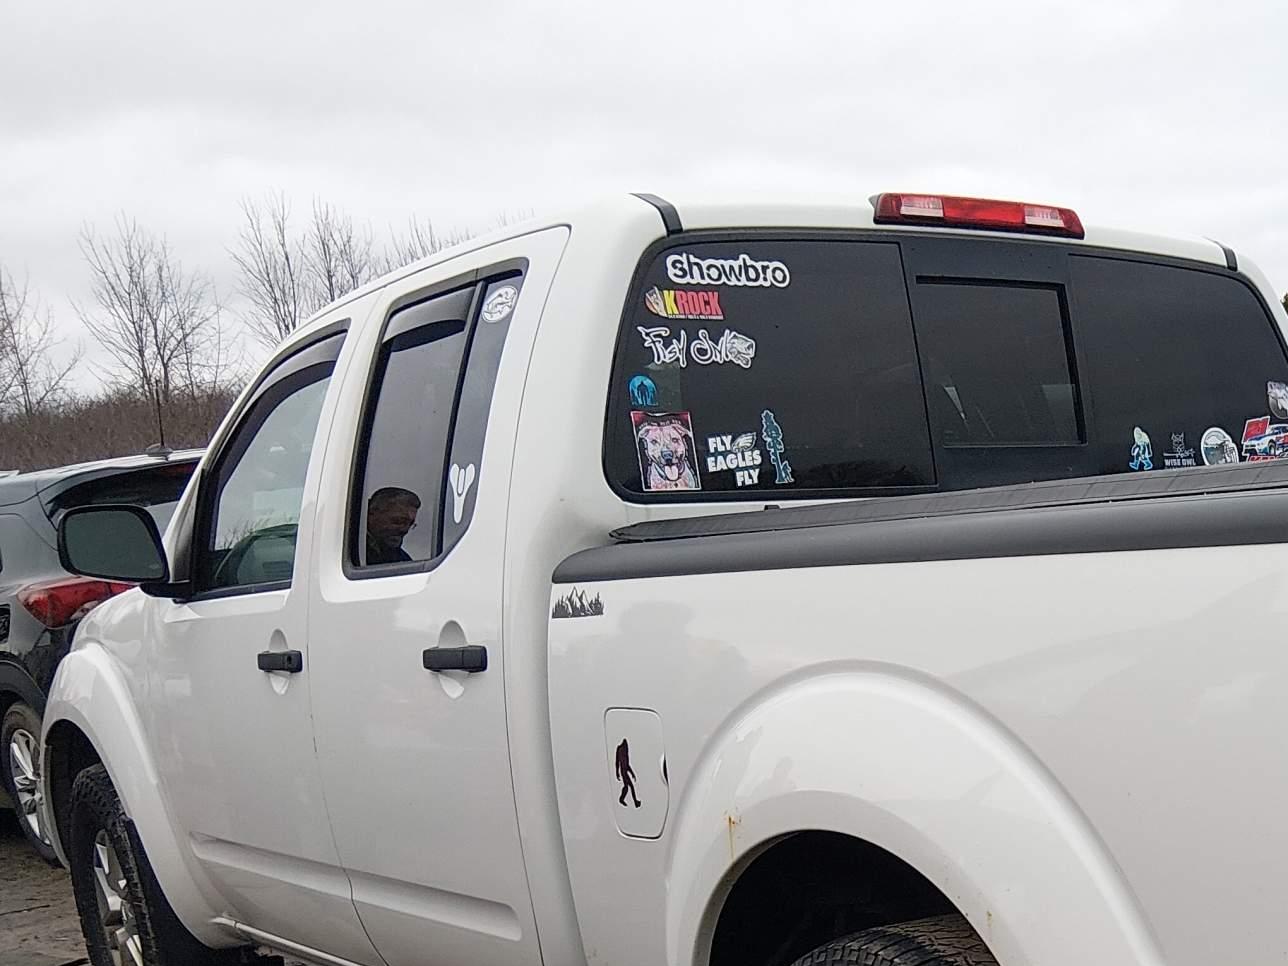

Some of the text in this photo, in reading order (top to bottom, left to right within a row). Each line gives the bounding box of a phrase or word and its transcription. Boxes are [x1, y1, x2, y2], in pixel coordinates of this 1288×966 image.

[663, 289, 722, 315] KROCK
[708, 435, 733, 453] FLY
[707, 450, 762, 472] EAGLES
[736, 468, 760, 487] FLY
